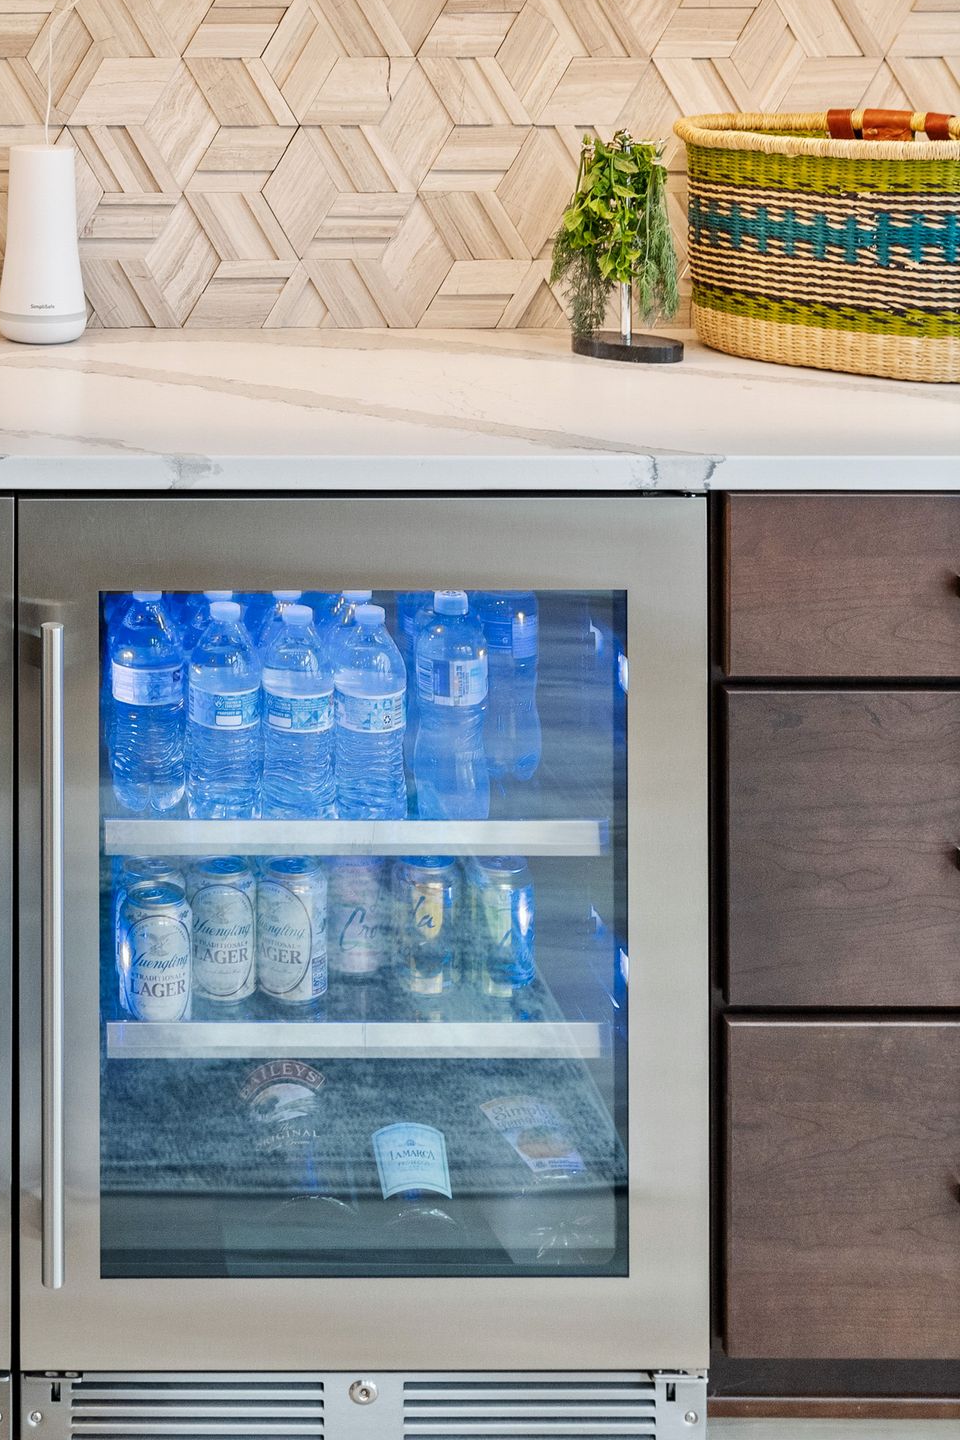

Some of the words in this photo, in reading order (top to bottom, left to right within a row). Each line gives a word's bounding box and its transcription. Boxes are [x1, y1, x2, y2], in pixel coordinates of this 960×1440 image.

[192, 918, 251, 940] Yuengling
[132, 948, 189, 973] Yuengling
[193, 944, 248, 964] LAGER
[259, 941, 303, 965] AGER
[130, 979, 186, 998] LAGER
[239, 1062, 317, 1100] BAILEYS
